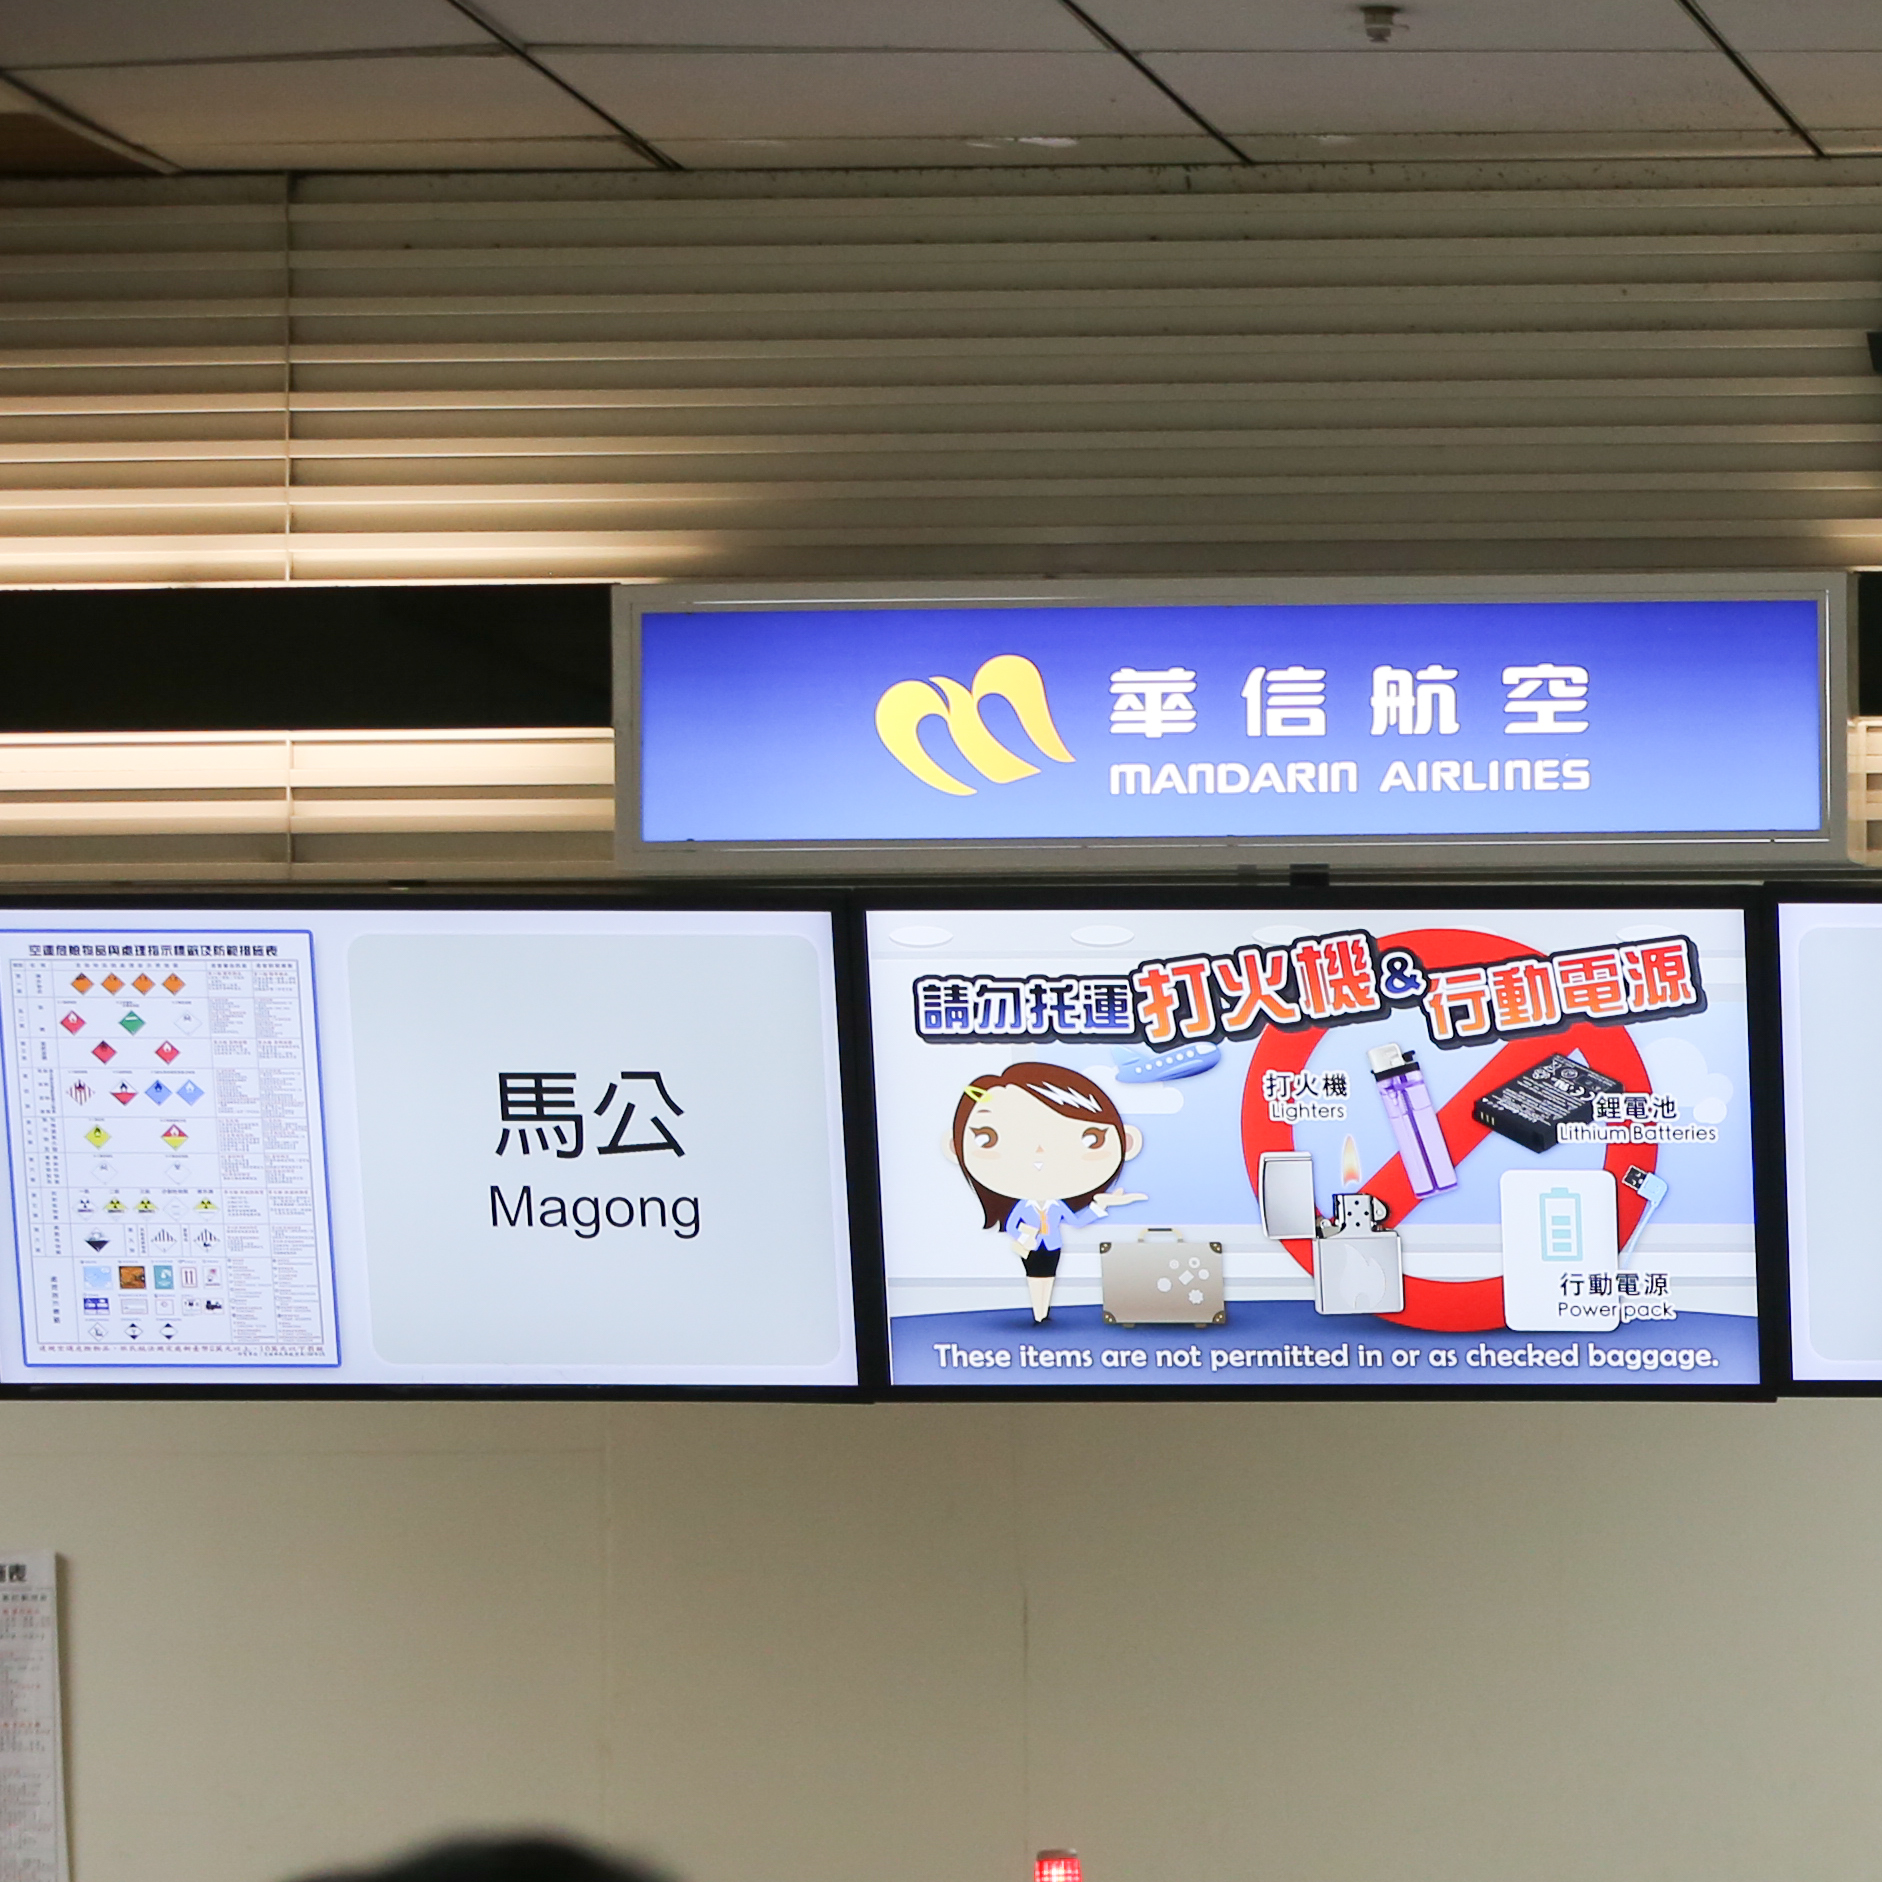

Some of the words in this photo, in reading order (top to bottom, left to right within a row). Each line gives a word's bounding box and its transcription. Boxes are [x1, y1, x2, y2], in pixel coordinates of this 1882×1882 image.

[1108, 662, 1592, 739] 華信航空
[1109, 760, 1359, 795] MANDARIN
[1379, 756, 1591, 793] AIRLINES
[1263, 1072, 1349, 1100] 打火機
[494, 1069, 687, 1160] 馬公
[1269, 1099, 1347, 1123] Lighters
[1596, 1094, 1678, 1120] 鋰電池
[1560, 1124, 1627, 1142] Lithium
[1633, 1124, 1717, 1142] Batteries
[488, 1184, 702, 1240] Magong
[1559, 1272, 1671, 1299] 行動電源
[1558, 1300, 1618, 1320] Power
[1621, 1300, 1677, 1322] pack
[933, 1343, 1012, 1368] These
[1019, 1343, 1094, 1368] items
[1100, 1350, 1148, 1368] are
[1155, 1345, 1202, 1368] not
[1210, 1344, 1350, 1371] permitted
[1357, 1344, 1384, 1367] in
[1391, 1348, 1420, 1367] or
[1428, 1348, 1458, 1367] as
[1465, 1343, 1580, 1368] checked
[1588, 1343, 1720, 1371] baggage.
